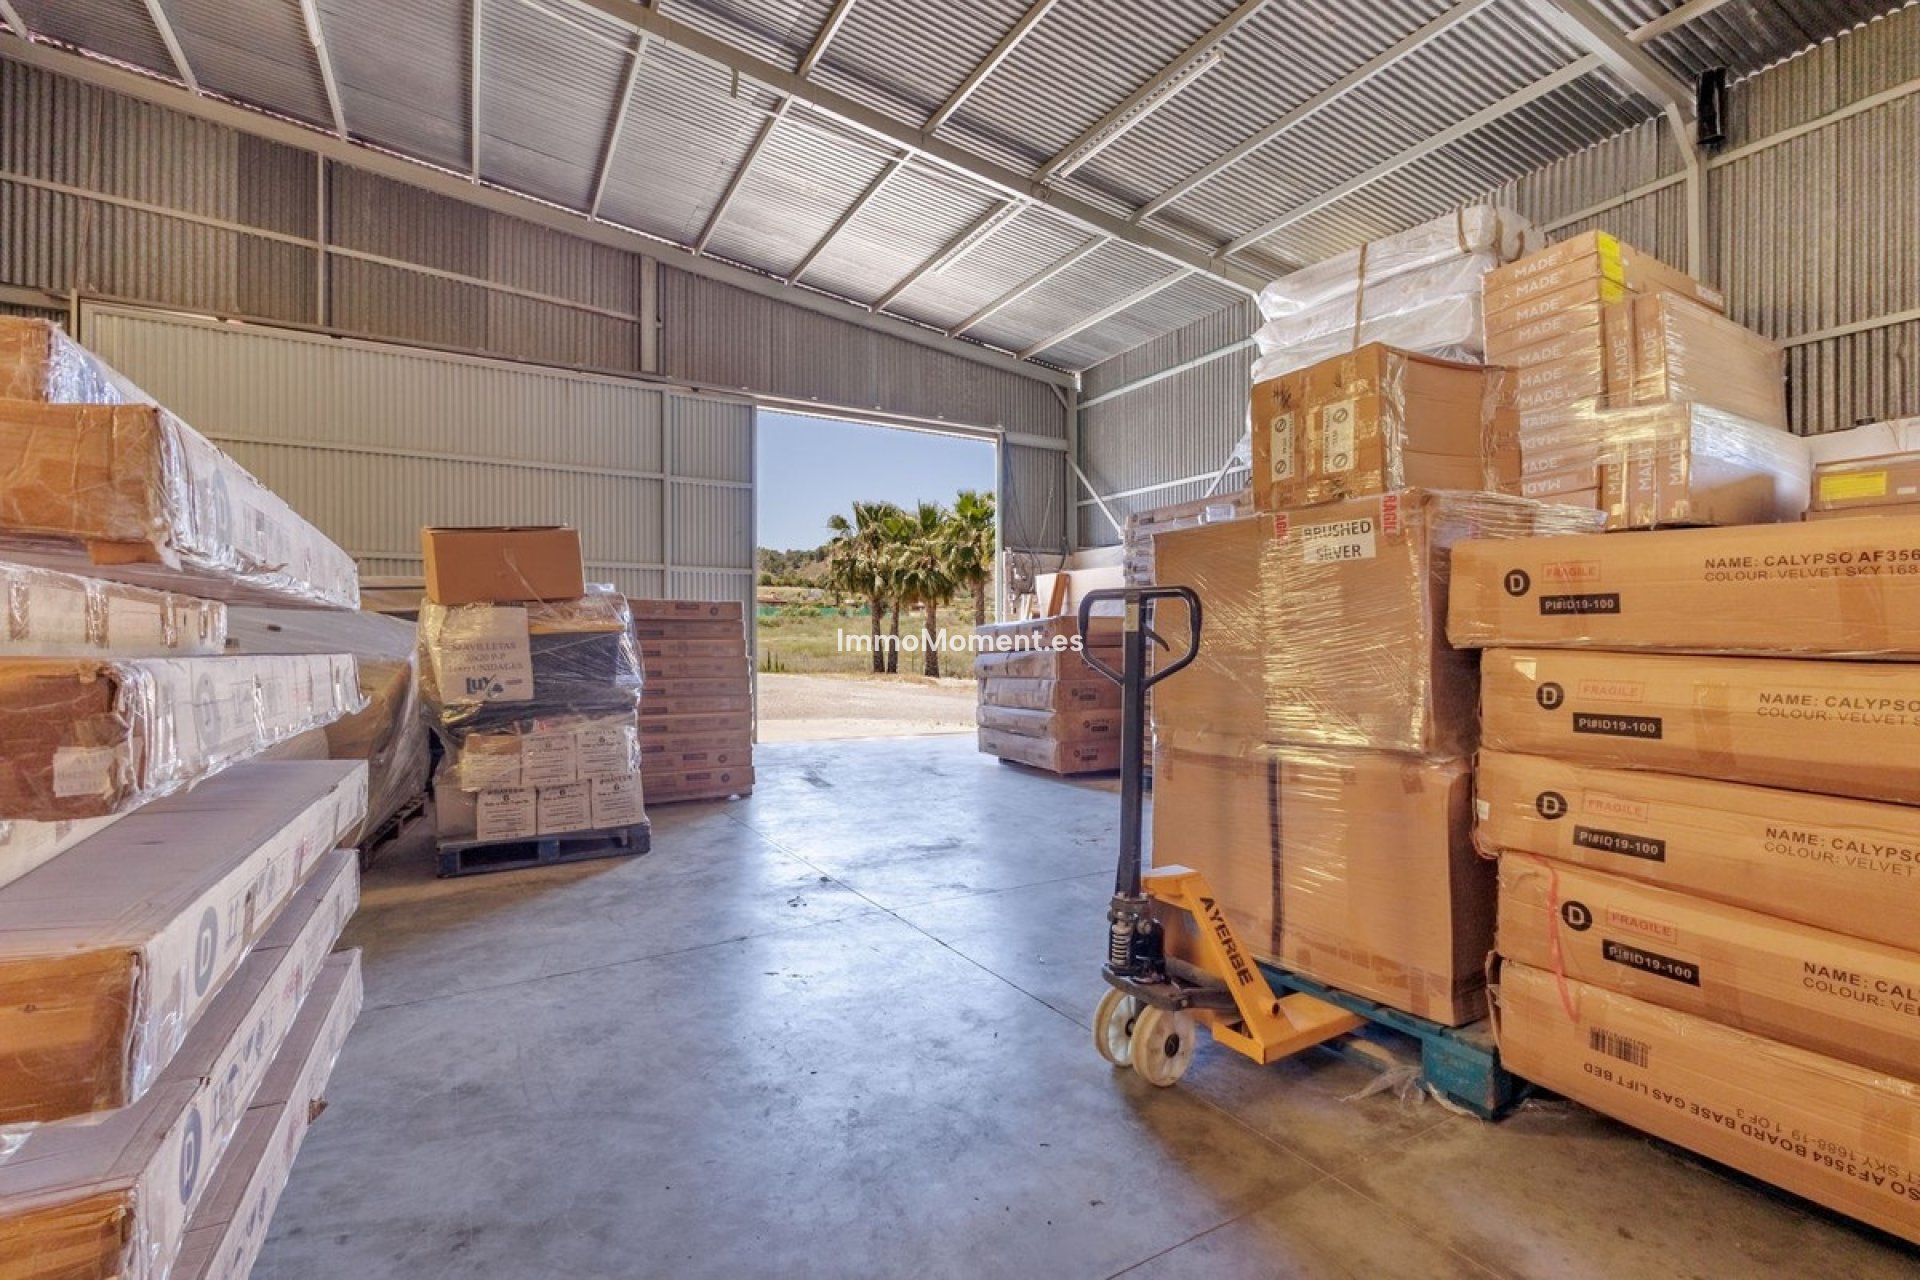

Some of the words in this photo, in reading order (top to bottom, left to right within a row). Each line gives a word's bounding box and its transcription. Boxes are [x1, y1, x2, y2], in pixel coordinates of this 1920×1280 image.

[1514, 254, 1559, 279] MADE
[1516, 272, 1560, 297] MADE
[1516, 298, 1560, 321] MADE
[1520, 317, 1561, 341] MADE
[1518, 344, 1562, 367] MADE
[1519, 367, 1562, 389] MADE
[1303, 520, 1371, 540] BRUSHED
[1546, 566, 1597, 577] FRAGILE
[1705, 556, 1759, 569] NAME:
[1764, 552, 1853, 567] CALYPSO
[1777, 567, 1841, 580] VELVET
[1846, 565, 1881, 577] SKY
[1583, 684, 1640, 697] FRAGILE
[1760, 692, 1818, 706] NAME:
[1757, 707, 1833, 721] COLOUR:
[1838, 711, 1908, 726] VELVET
[1585, 799, 1643, 816] FRAGILE
[1765, 827, 1825, 847] NAME:
[1764, 841, 1840, 864] COLOUR:
[1845, 855, 1913, 877] VELVET
[1611, 911, 1672, 937] FRAGILE
[1200, 897, 1253, 987] AYERBE
[1804, 961, 1868, 989] NAME:
[1803, 977, 1887, 1007] COLOUR:
[1583, 1062, 1613, 1081] BED
[1616, 1075, 1649, 1095] LIFT
[1652, 1088, 1686, 1109] GAS
[1690, 1103, 1736, 1129] BASE
[1736, 1108, 1745, 1119] 3
[1749, 1114, 1770, 1129] OF
[1775, 1122, 1782, 1133] 1
[1741, 1124, 1807, 1158] BOARD
[1791, 1128, 1856, 1161] 1688-19
[1813, 1151, 1886, 1186] AF3564
[1861, 1156, 1899, 1178] SKY
